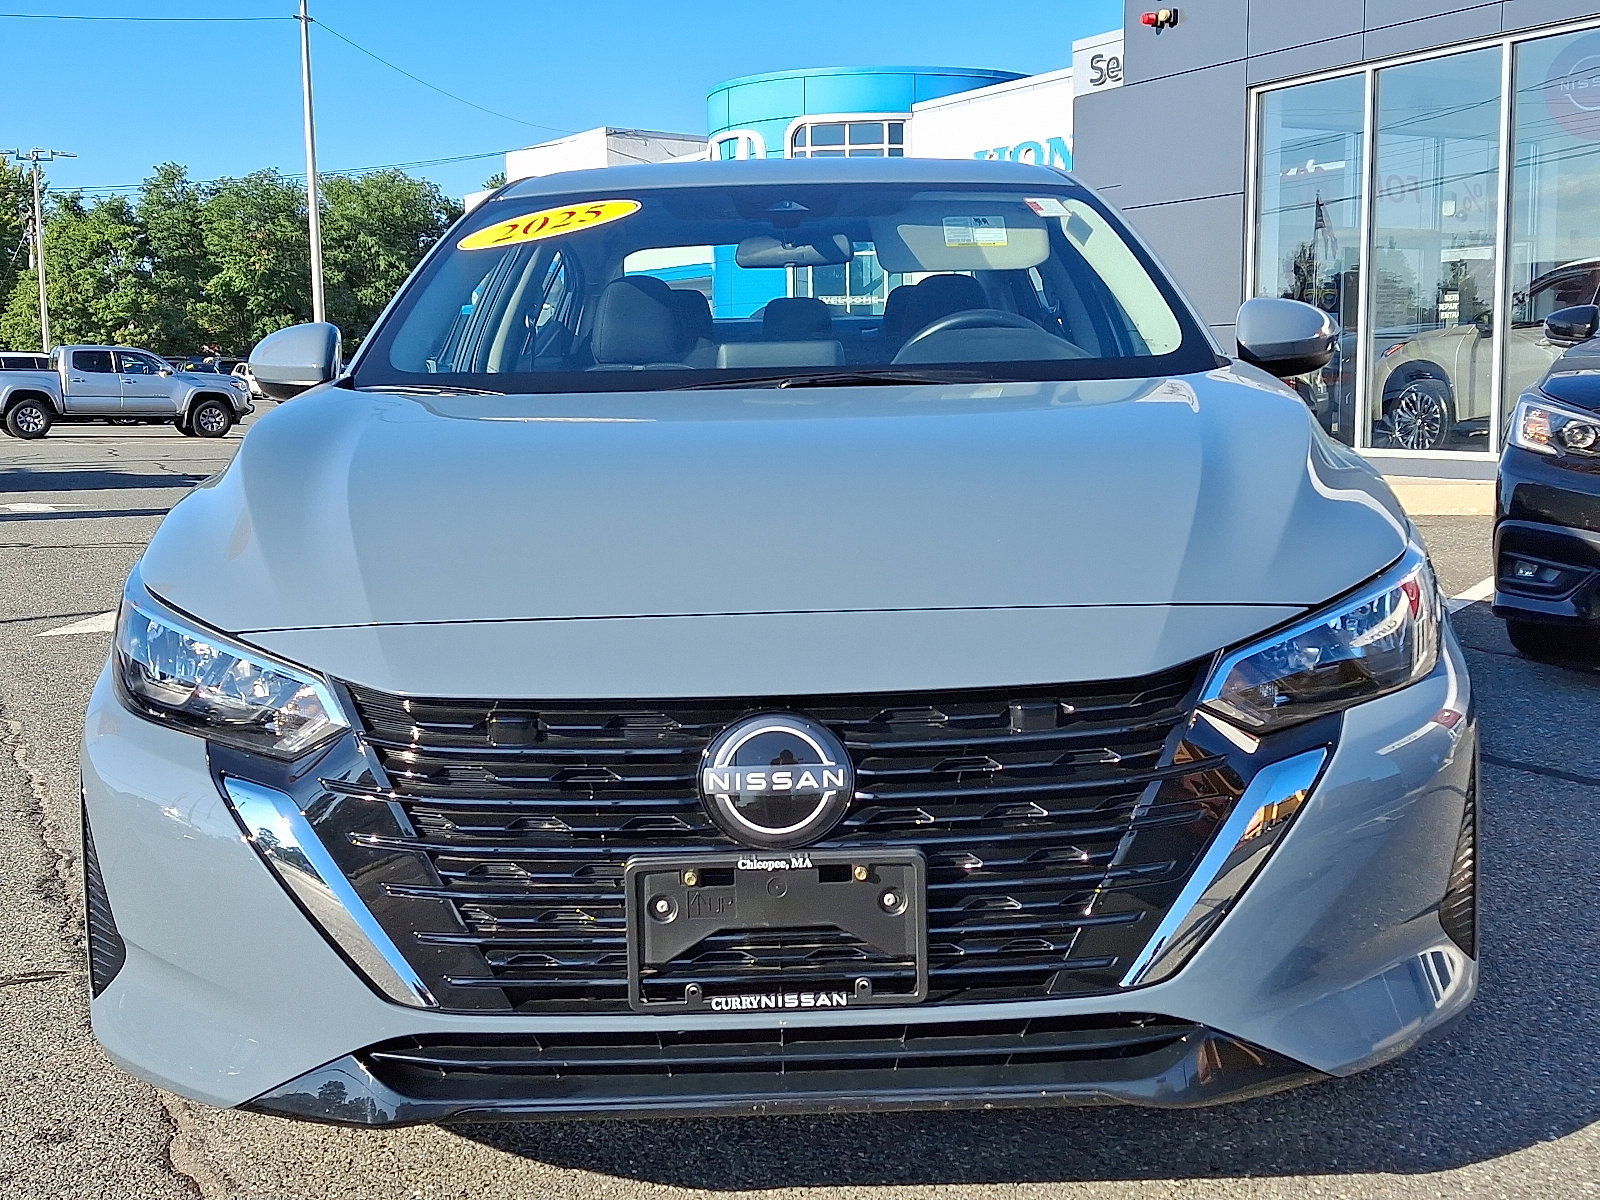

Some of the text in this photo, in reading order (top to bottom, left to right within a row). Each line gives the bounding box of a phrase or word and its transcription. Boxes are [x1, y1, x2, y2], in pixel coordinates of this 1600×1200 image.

[1090, 53, 1123, 86] Se
[492, 204, 606, 243] 2025
[818, 296, 879, 306] WELCOME
[708, 769, 844, 791] NISSAN
[737, 857, 812, 871] Chicopee, MA
